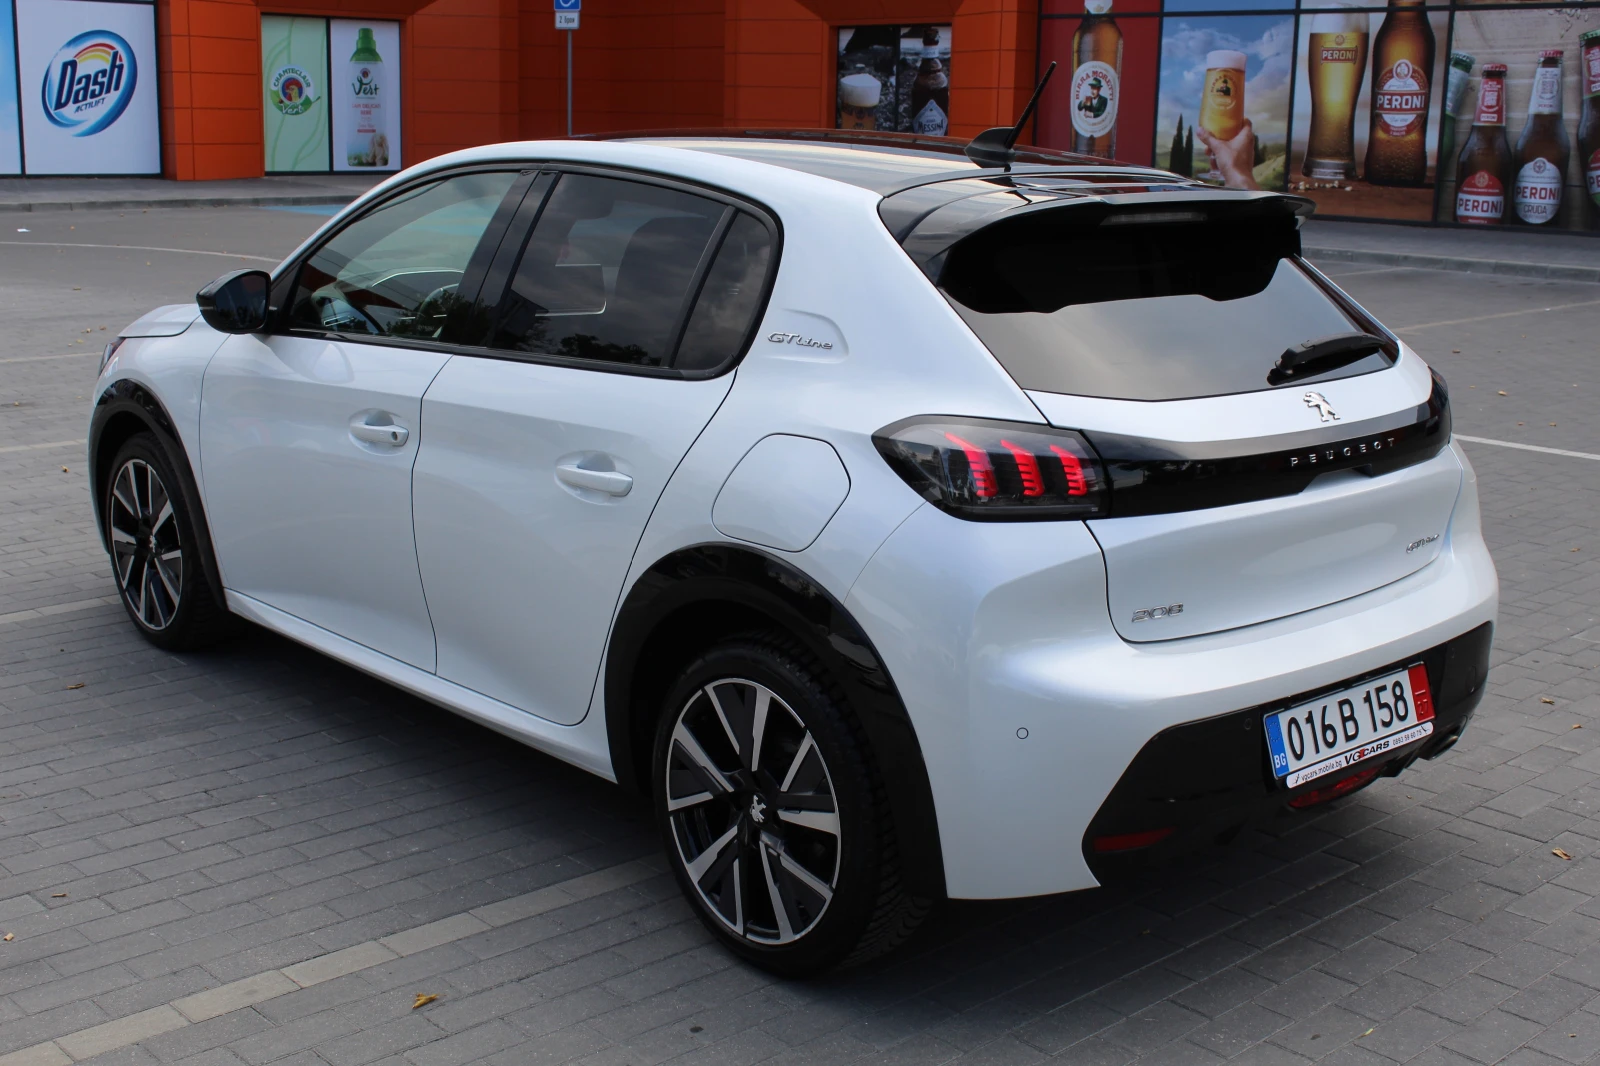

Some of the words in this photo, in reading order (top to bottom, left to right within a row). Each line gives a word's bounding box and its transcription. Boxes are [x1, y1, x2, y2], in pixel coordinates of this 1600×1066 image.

[1322, 50, 1355, 60] PERONI
[53, 50, 124, 112] Dash
[273, 68, 311, 88] CHANTECLAIR
[352, 76, 380, 96] Vert
[1075, 72, 1091, 100] BIRRA
[1091, 70, 1114, 101] MORETTI
[74, 97, 107, 114] ACTILIFT
[281, 103, 304, 115] Vert
[1376, 95, 1425, 109] PERONI
[1515, 186, 1560, 201] PERONI
[1457, 198, 1502, 214] PERONI
[1523, 204, 1548, 215] CRUDA
[1290, 437, 1395, 467] PEUGEOT
[1131, 602, 1184, 623] 208
[1274, 752, 1287, 769] BG
